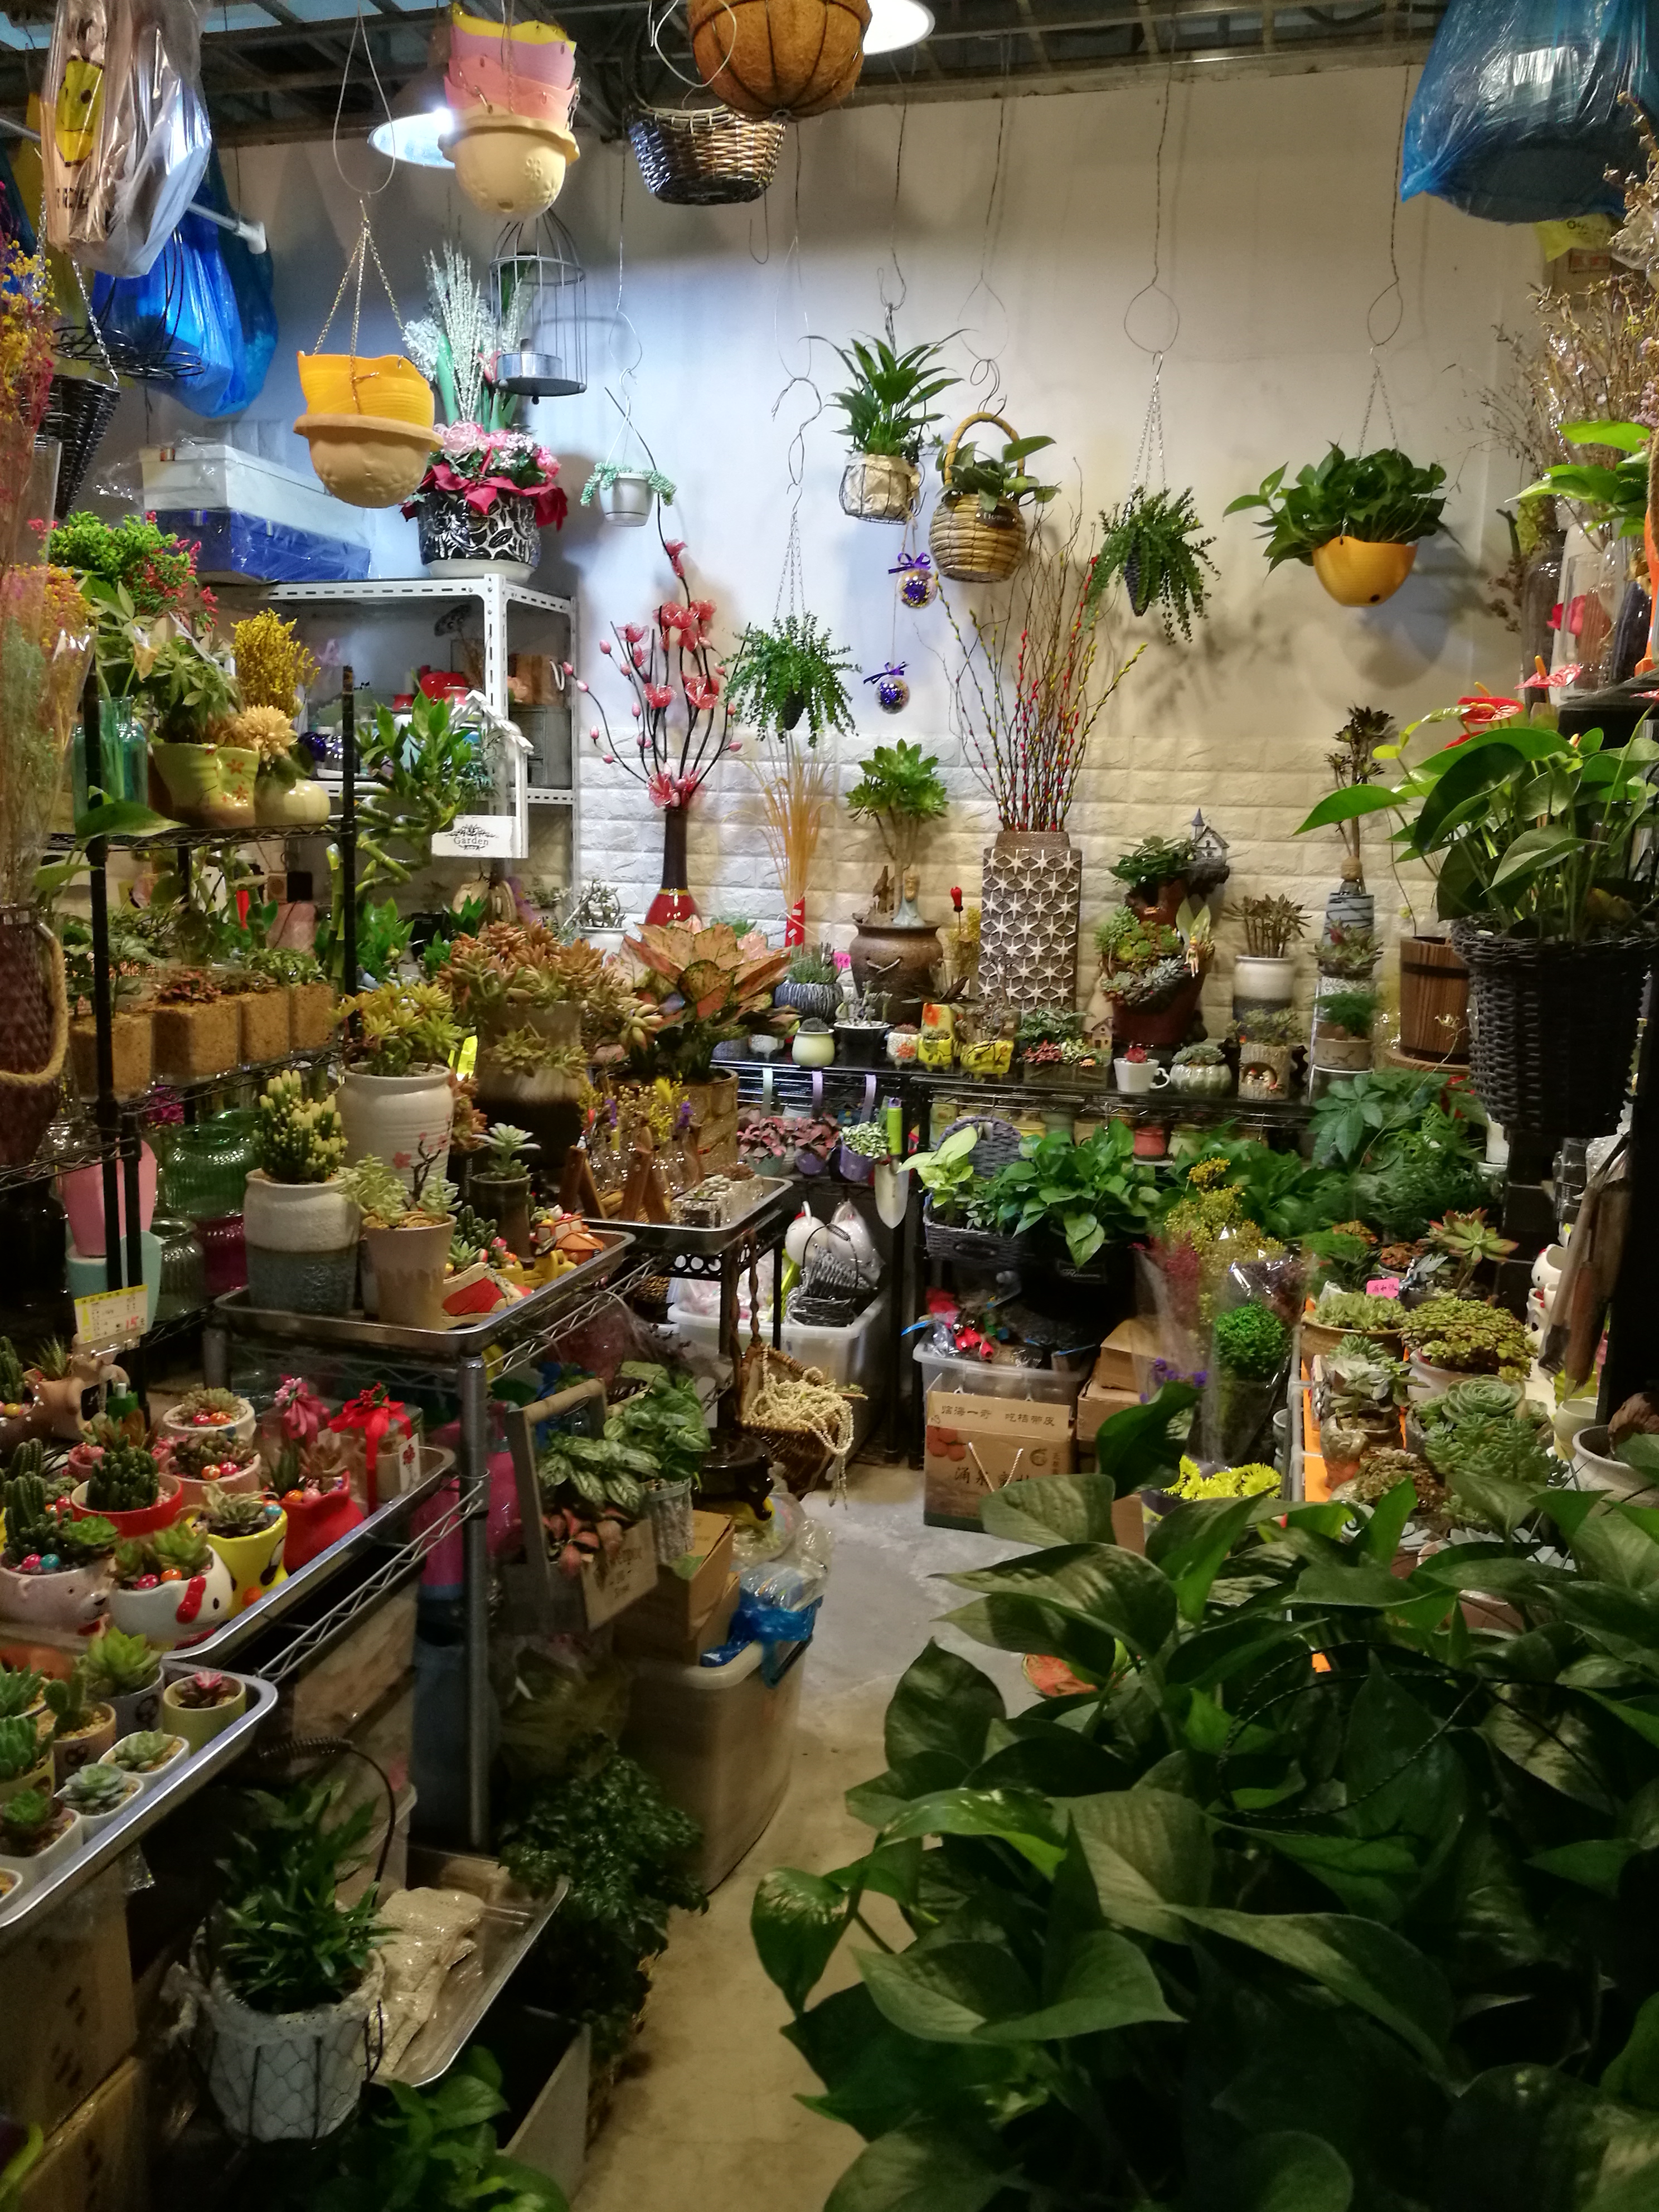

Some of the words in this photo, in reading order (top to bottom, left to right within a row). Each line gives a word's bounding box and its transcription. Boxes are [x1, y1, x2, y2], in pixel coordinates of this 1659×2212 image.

[454, 837, 488, 845] Garden
[955, 1467, 1030, 1489] 涌泉蜜
